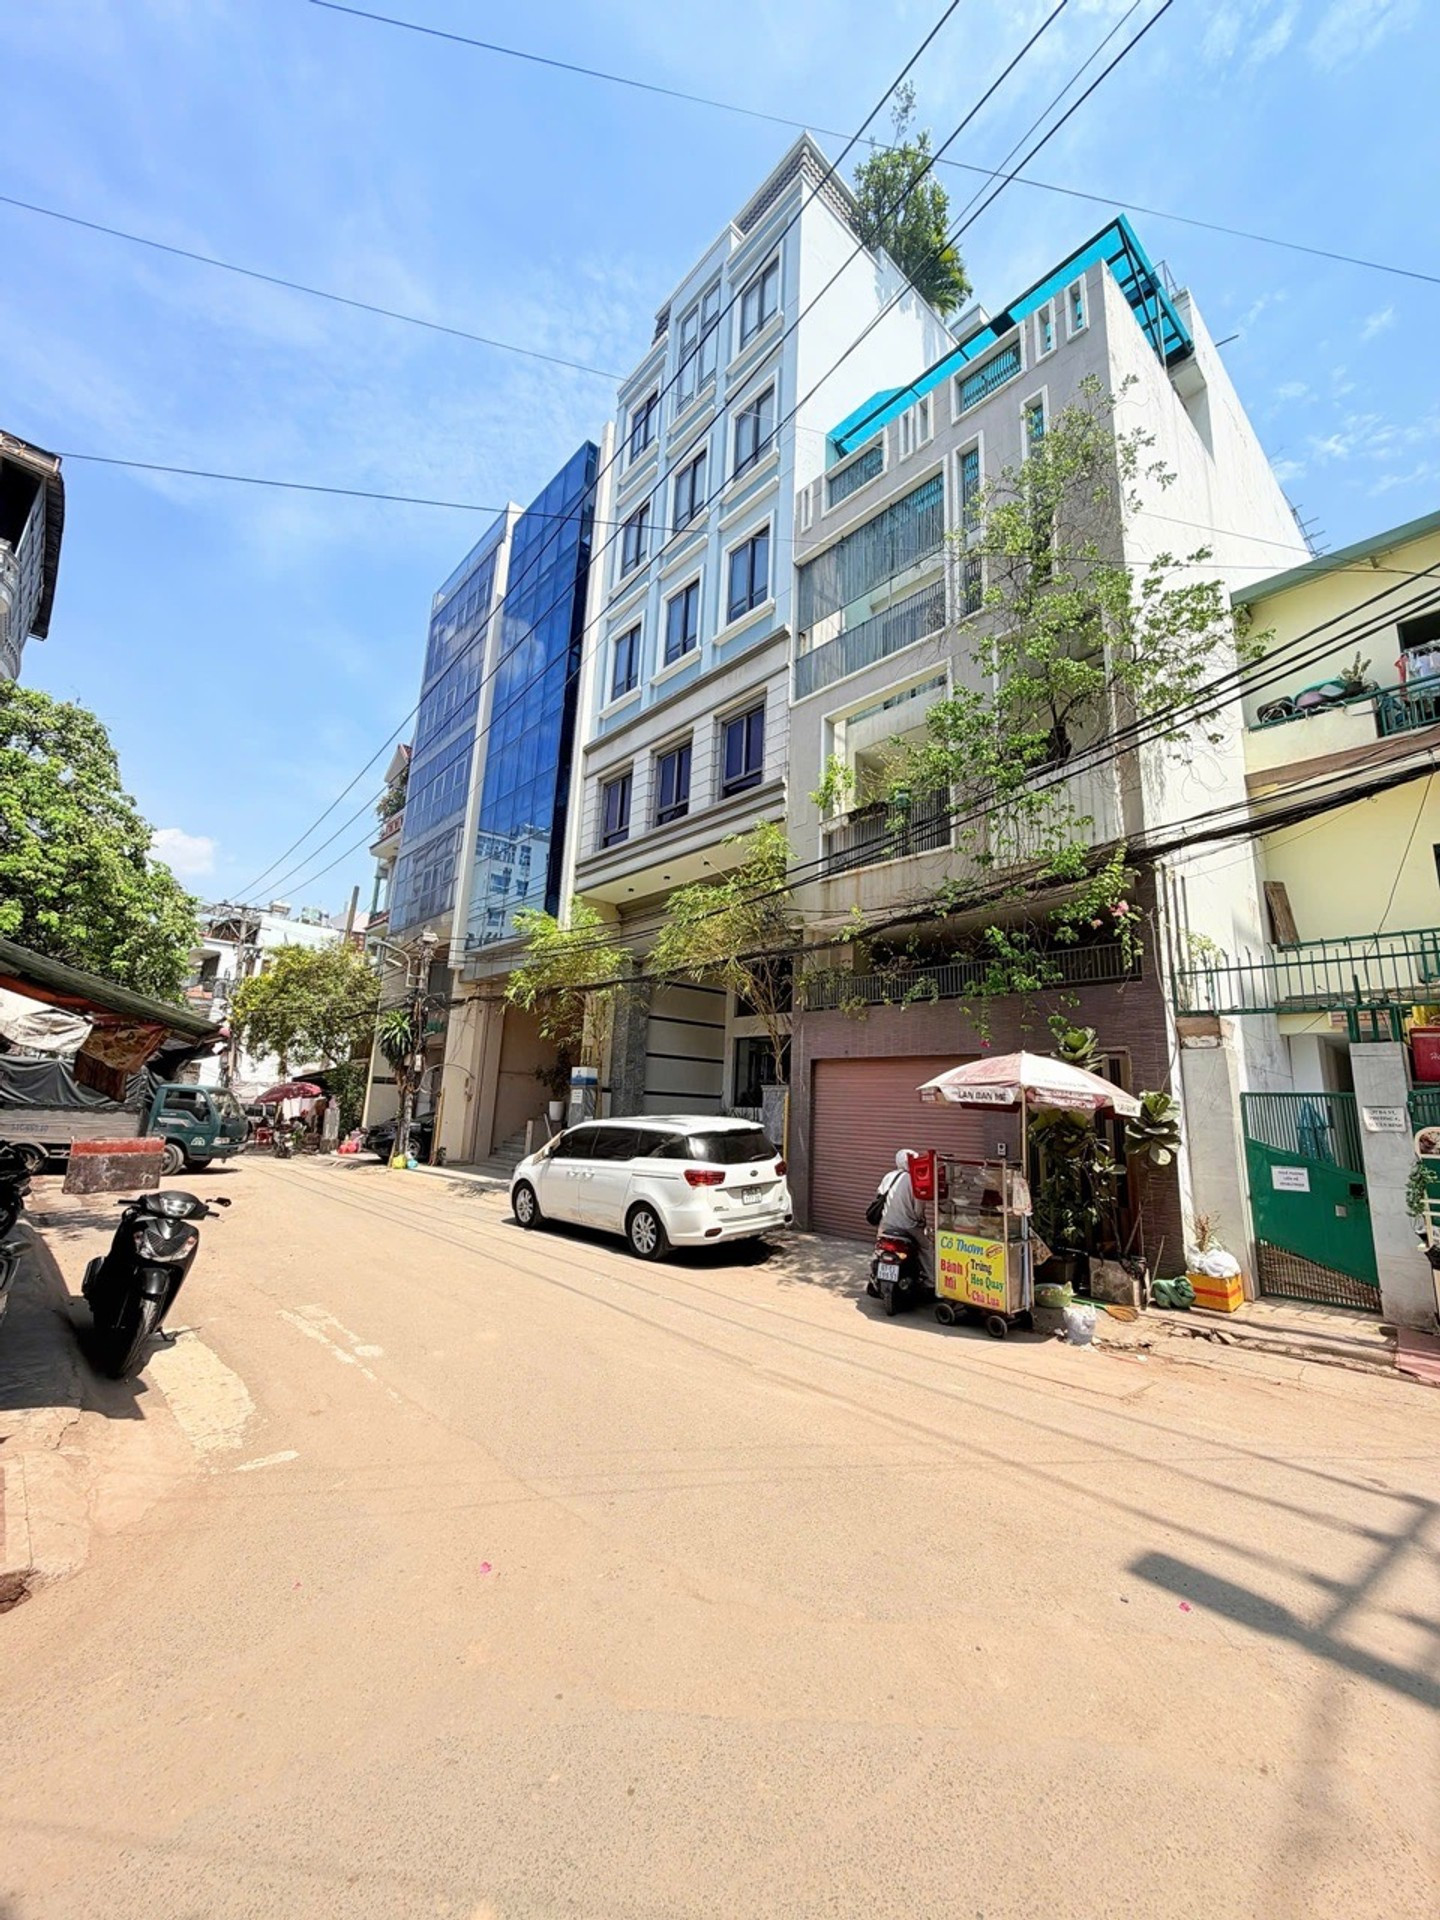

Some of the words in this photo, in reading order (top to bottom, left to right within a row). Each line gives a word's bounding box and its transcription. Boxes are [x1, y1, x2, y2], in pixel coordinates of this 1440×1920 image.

[941, 1236, 953, 1249] Cô
[941, 1258, 963, 1275] Bánh
[971, 1273, 983, 1286] Heo
[986, 1277, 1004, 1292] Quay
